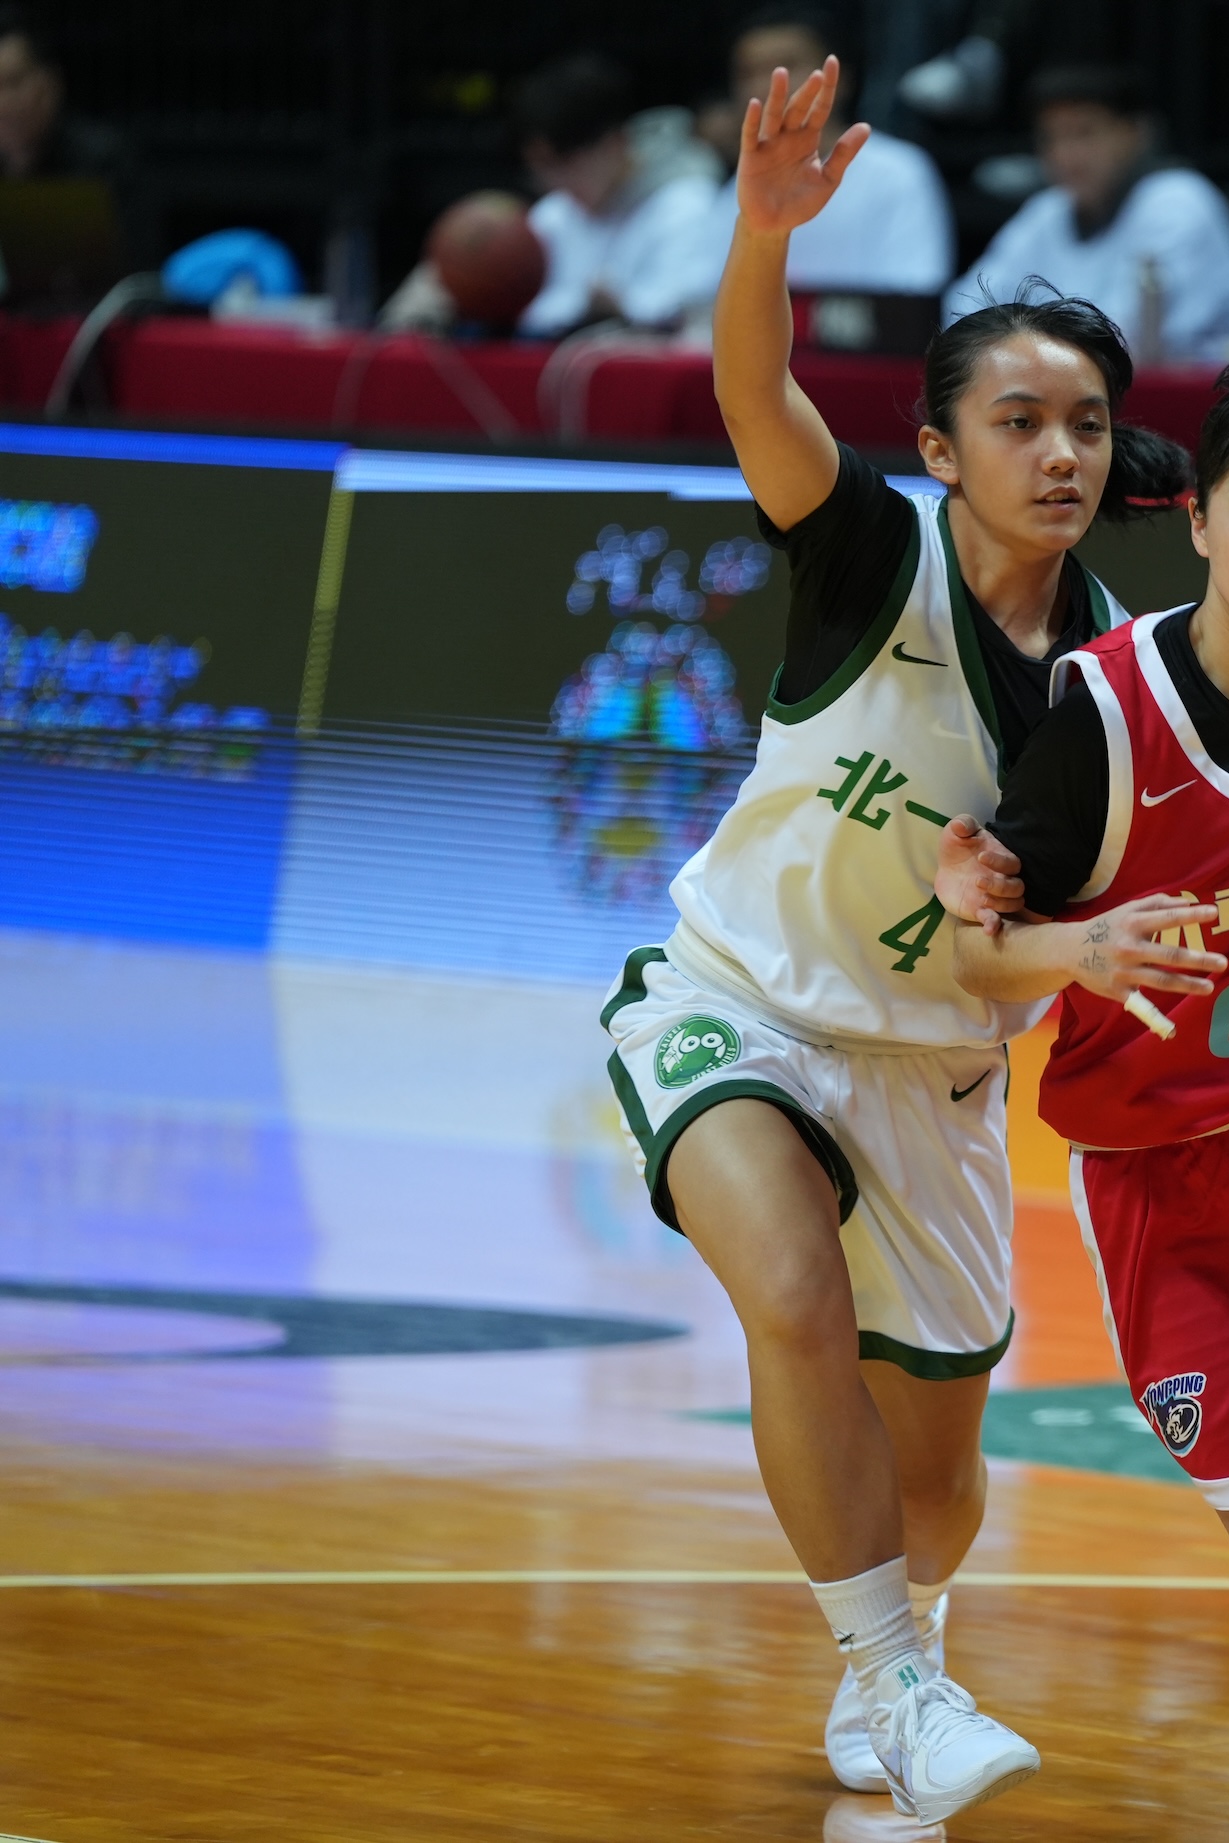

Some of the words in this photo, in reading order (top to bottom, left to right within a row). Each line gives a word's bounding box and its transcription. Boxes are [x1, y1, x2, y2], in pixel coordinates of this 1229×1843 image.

[878, 894, 946, 973] 4
[659, 1025, 682, 1053] TAIPEI
[1142, 1375, 1205, 1419] YONGPING
